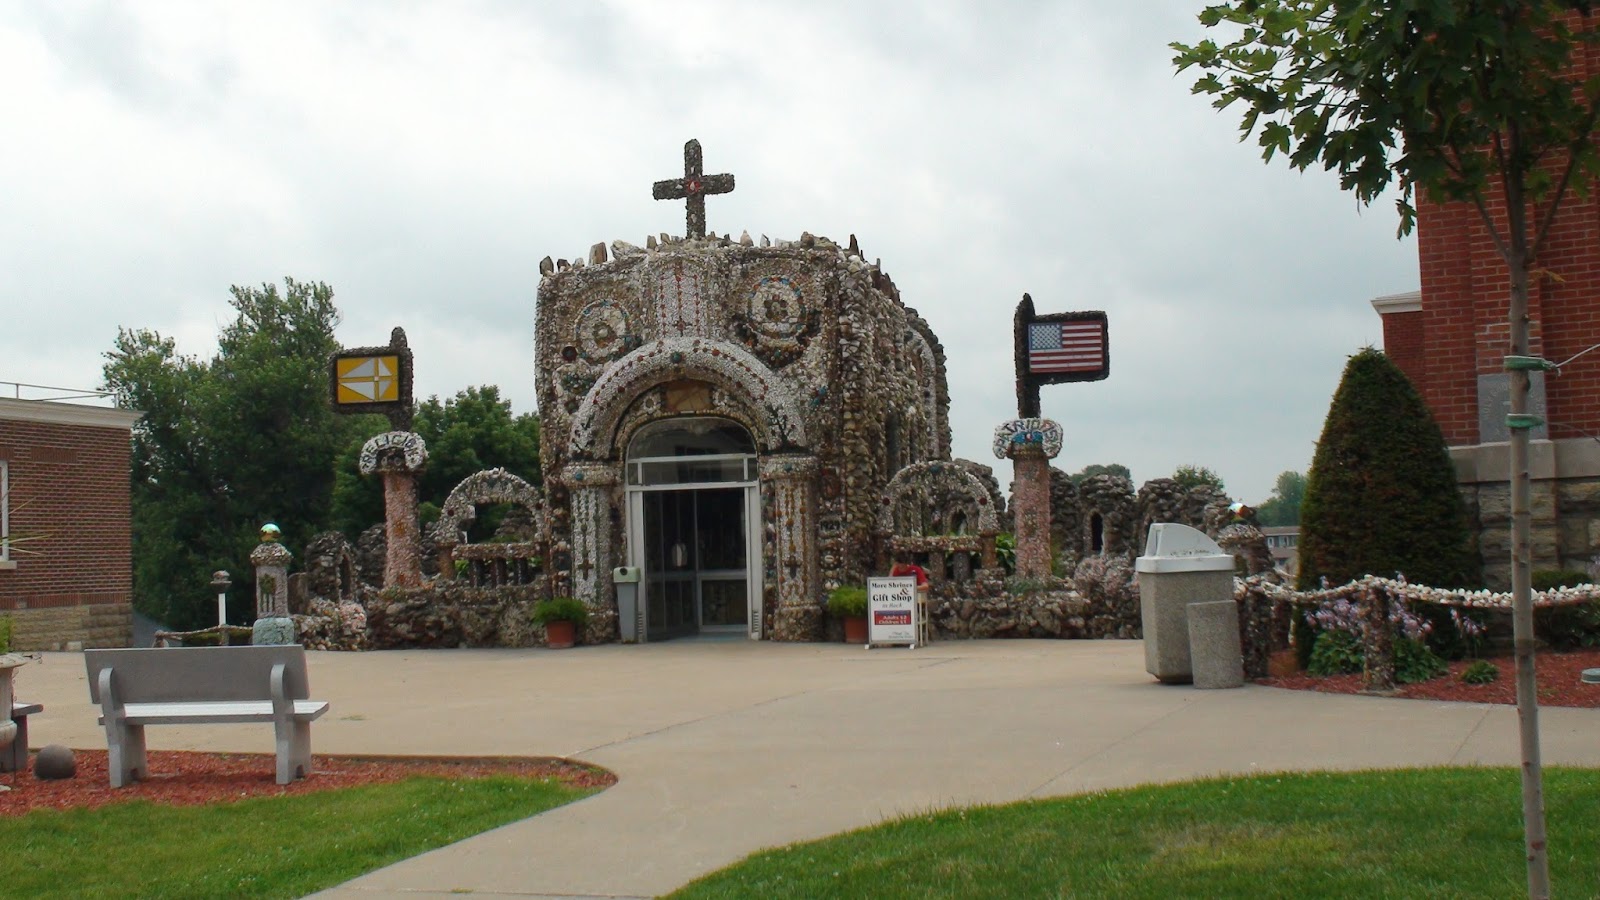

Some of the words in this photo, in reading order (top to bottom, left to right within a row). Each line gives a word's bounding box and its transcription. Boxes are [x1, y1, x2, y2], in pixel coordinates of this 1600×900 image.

[900, 587, 909, 596] &
[872, 593, 889, 602] Gift
[891, 593, 912, 602] Shop
